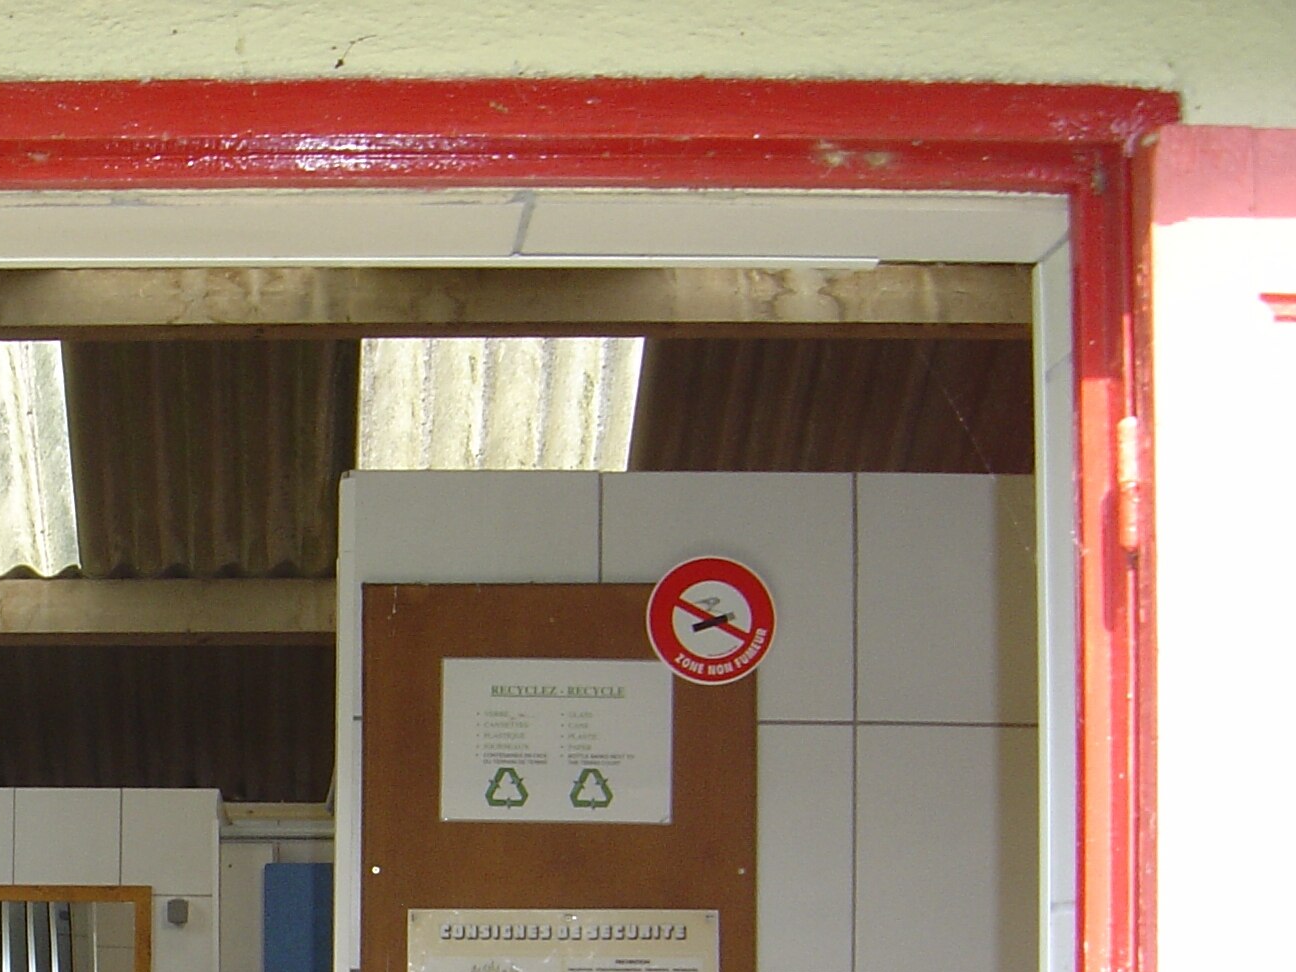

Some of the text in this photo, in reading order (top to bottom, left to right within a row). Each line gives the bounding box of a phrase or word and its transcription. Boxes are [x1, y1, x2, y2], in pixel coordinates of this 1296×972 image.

[675, 653, 704, 675] ZONE
[707, 661, 734, 676] NON
[734, 627, 768, 669] FUMEUR
[490, 685, 557, 698] RECYCLEZ
[568, 686, 625, 699] RECYCLE
[440, 924, 552, 940] CONSIGNES
[557, 925, 582, 940] DE
